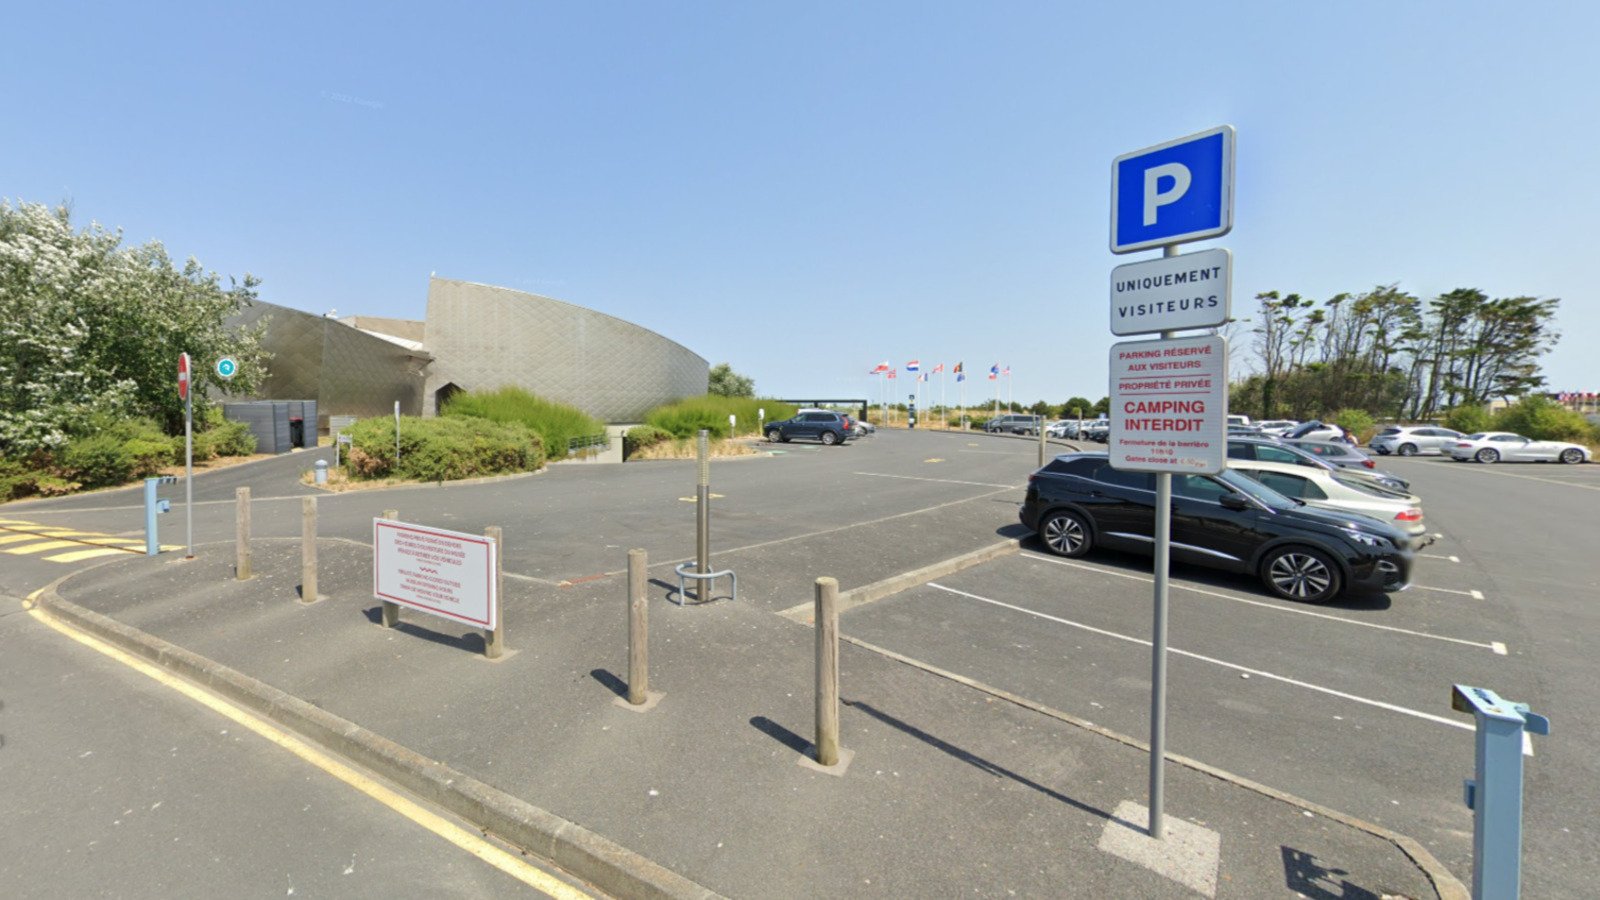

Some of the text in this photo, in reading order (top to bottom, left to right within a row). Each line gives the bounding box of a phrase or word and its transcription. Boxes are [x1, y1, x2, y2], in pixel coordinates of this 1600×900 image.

[1143, 162, 1192, 226] P
[1116, 266, 1221, 293] UNIQUEMENT
[1118, 295, 1219, 318] VISITEURS
[1119, 345, 1211, 360] PARKING RÉSERVÉ
[1128, 360, 1201, 371] AUX VISITEURS
[1119, 378, 1211, 390] PROPRIÉTÉ PRIVÉE
[1124, 400, 1205, 414] CAMPING
[1124, 418, 1204, 431] INTERDIT
[1119, 439, 1156, 447] Fermeture
[1157, 439, 1168, 447] de
